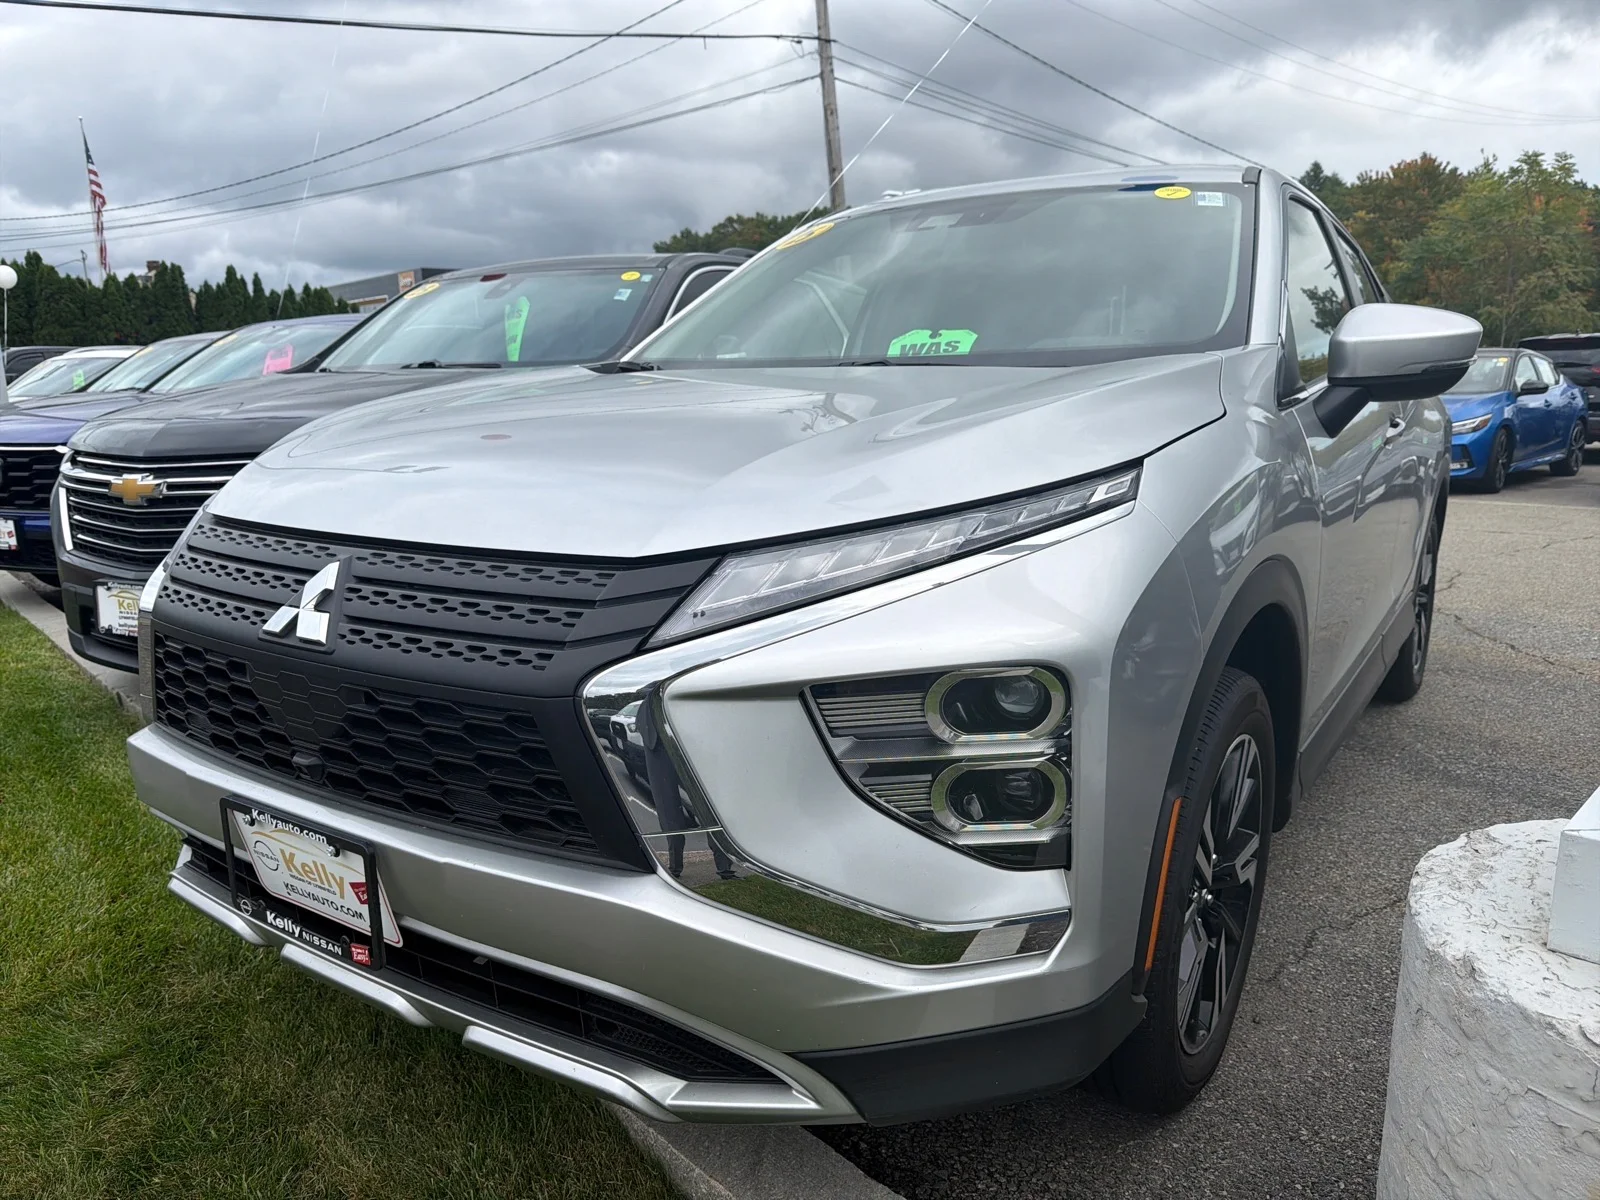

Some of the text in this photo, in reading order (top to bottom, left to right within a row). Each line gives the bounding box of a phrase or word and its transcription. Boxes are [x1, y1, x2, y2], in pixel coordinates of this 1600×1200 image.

[900, 341, 960, 357] WAS
[117, 599, 139, 611] Kell
[252, 808, 327, 845] Kellyauto.com
[279, 848, 345, 900] Kelly
[283, 881, 367, 922] KELLYAUTO.COM
[266, 911, 301, 937] Kelly
[302, 931, 342, 956] NISSAN
